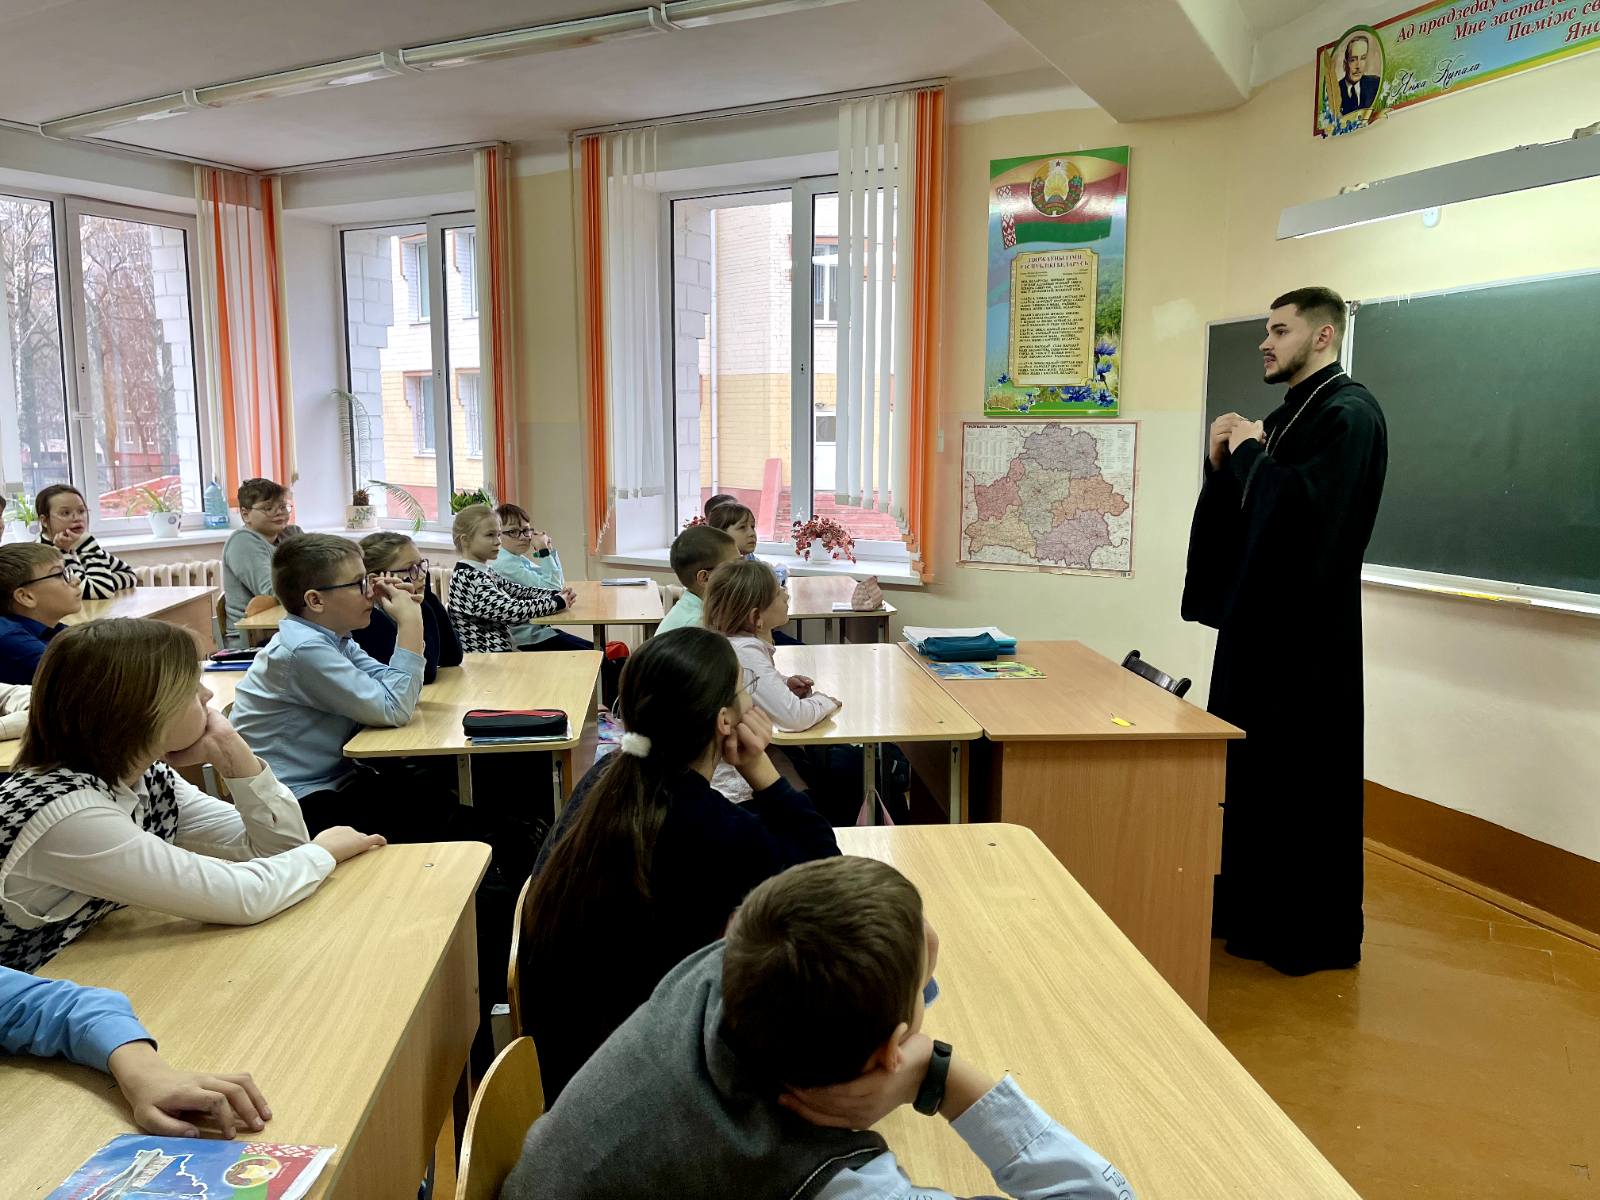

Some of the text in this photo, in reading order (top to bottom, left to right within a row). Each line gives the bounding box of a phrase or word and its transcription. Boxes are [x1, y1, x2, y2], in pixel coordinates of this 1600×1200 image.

[1396, 24, 1415, 42] Ад
[1453, 20, 1487, 40] Мне
[1507, 7, 1577, 41] Паміж
[1431, 54, 1482, 90] Купала
